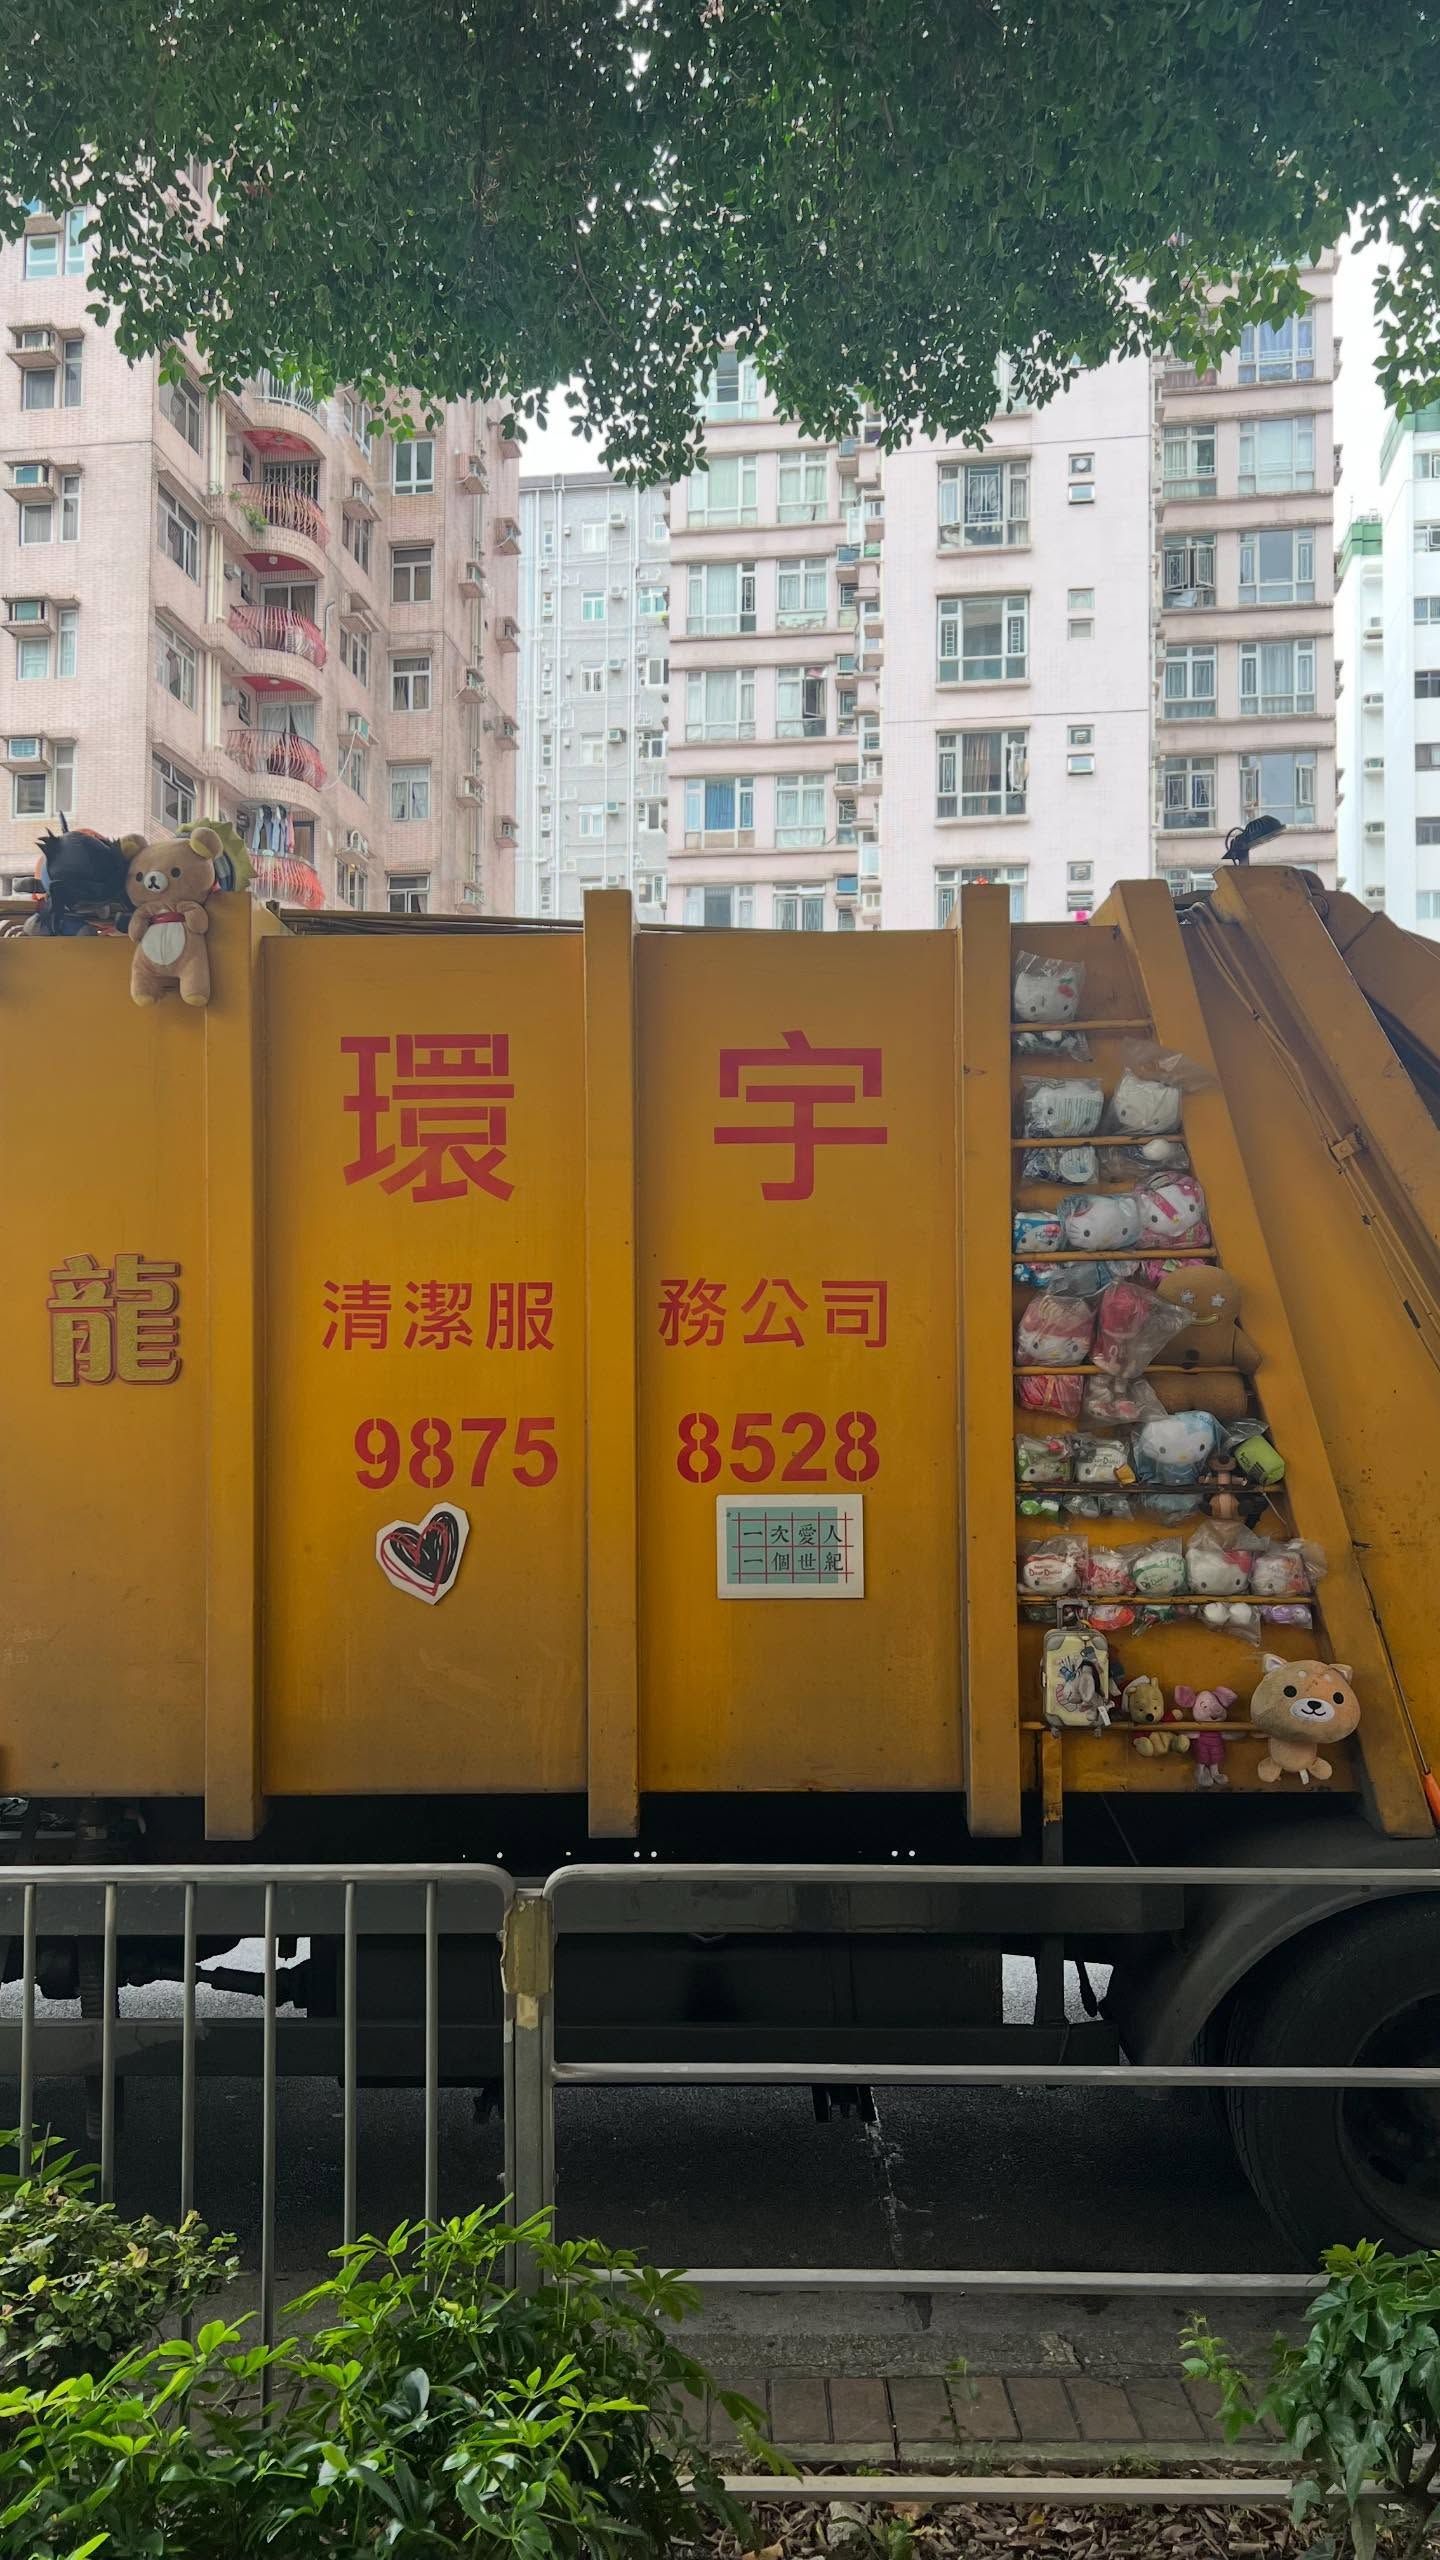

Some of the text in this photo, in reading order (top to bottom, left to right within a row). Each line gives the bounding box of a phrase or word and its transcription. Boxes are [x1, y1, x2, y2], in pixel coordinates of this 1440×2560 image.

[341, 1030, 888, 1202] 環 宇
[47, 1253, 182, 1387] 龍
[322, 1278, 888, 1351] 清潔服 務公司
[354, 1411, 880, 1489] 9875 8528
[743, 1523, 843, 1546] 一次愛人
[743, 1551, 844, 1572] 一個世紀
